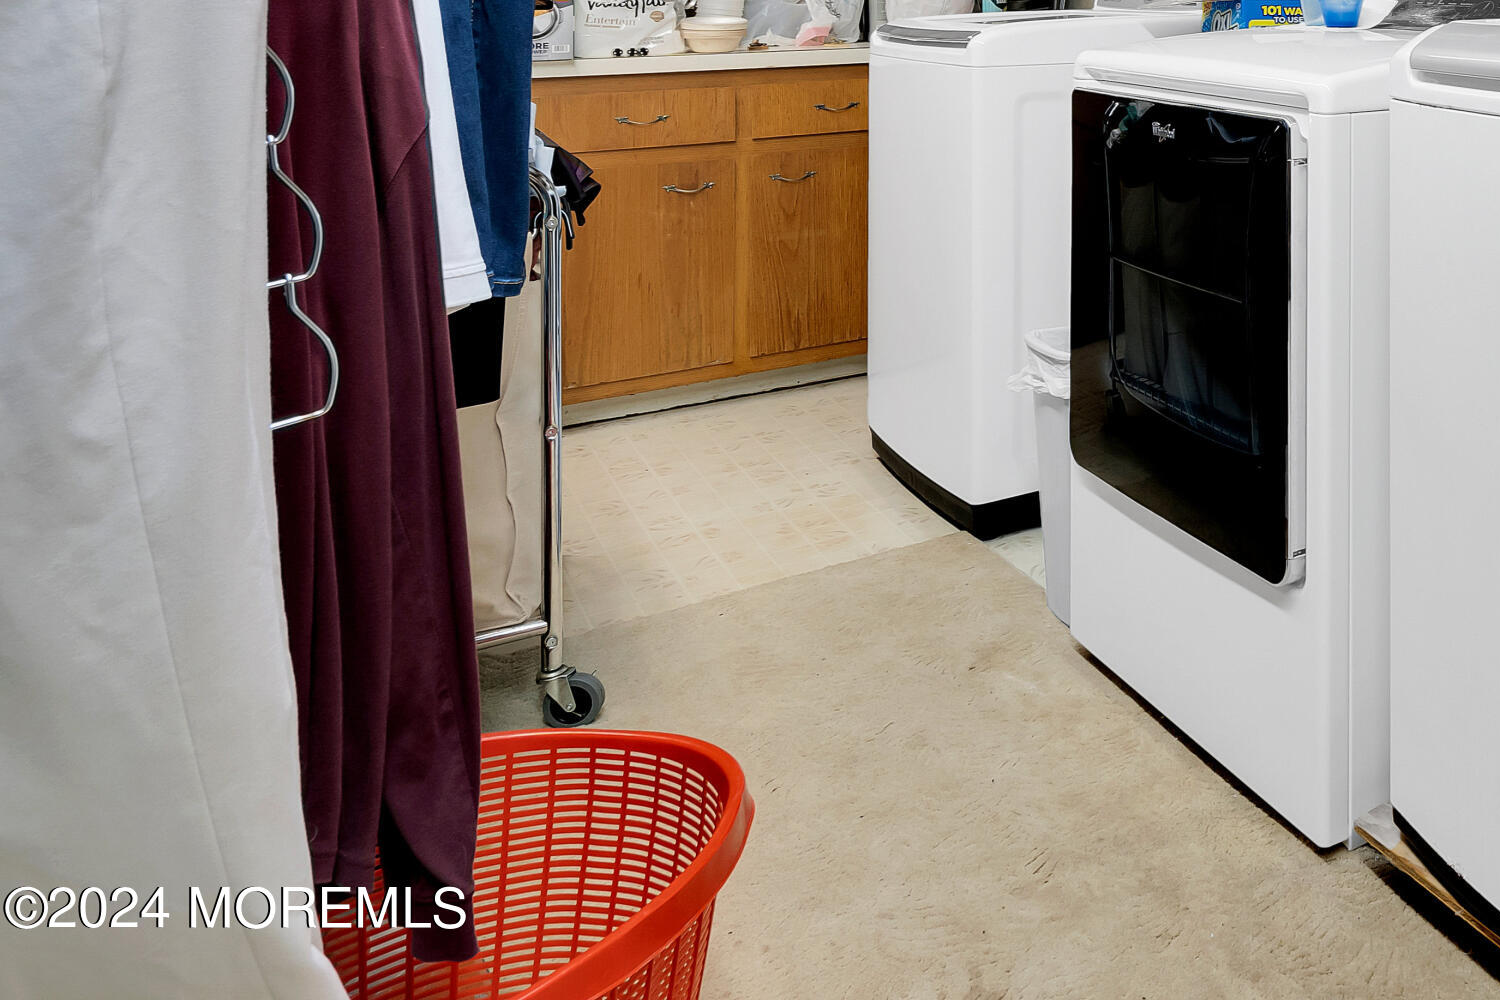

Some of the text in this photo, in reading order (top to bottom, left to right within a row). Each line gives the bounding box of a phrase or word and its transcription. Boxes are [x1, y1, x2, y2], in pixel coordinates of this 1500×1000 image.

[1262, 6, 1303, 16] 101 WA
[1273, 16, 1286, 24] TO
